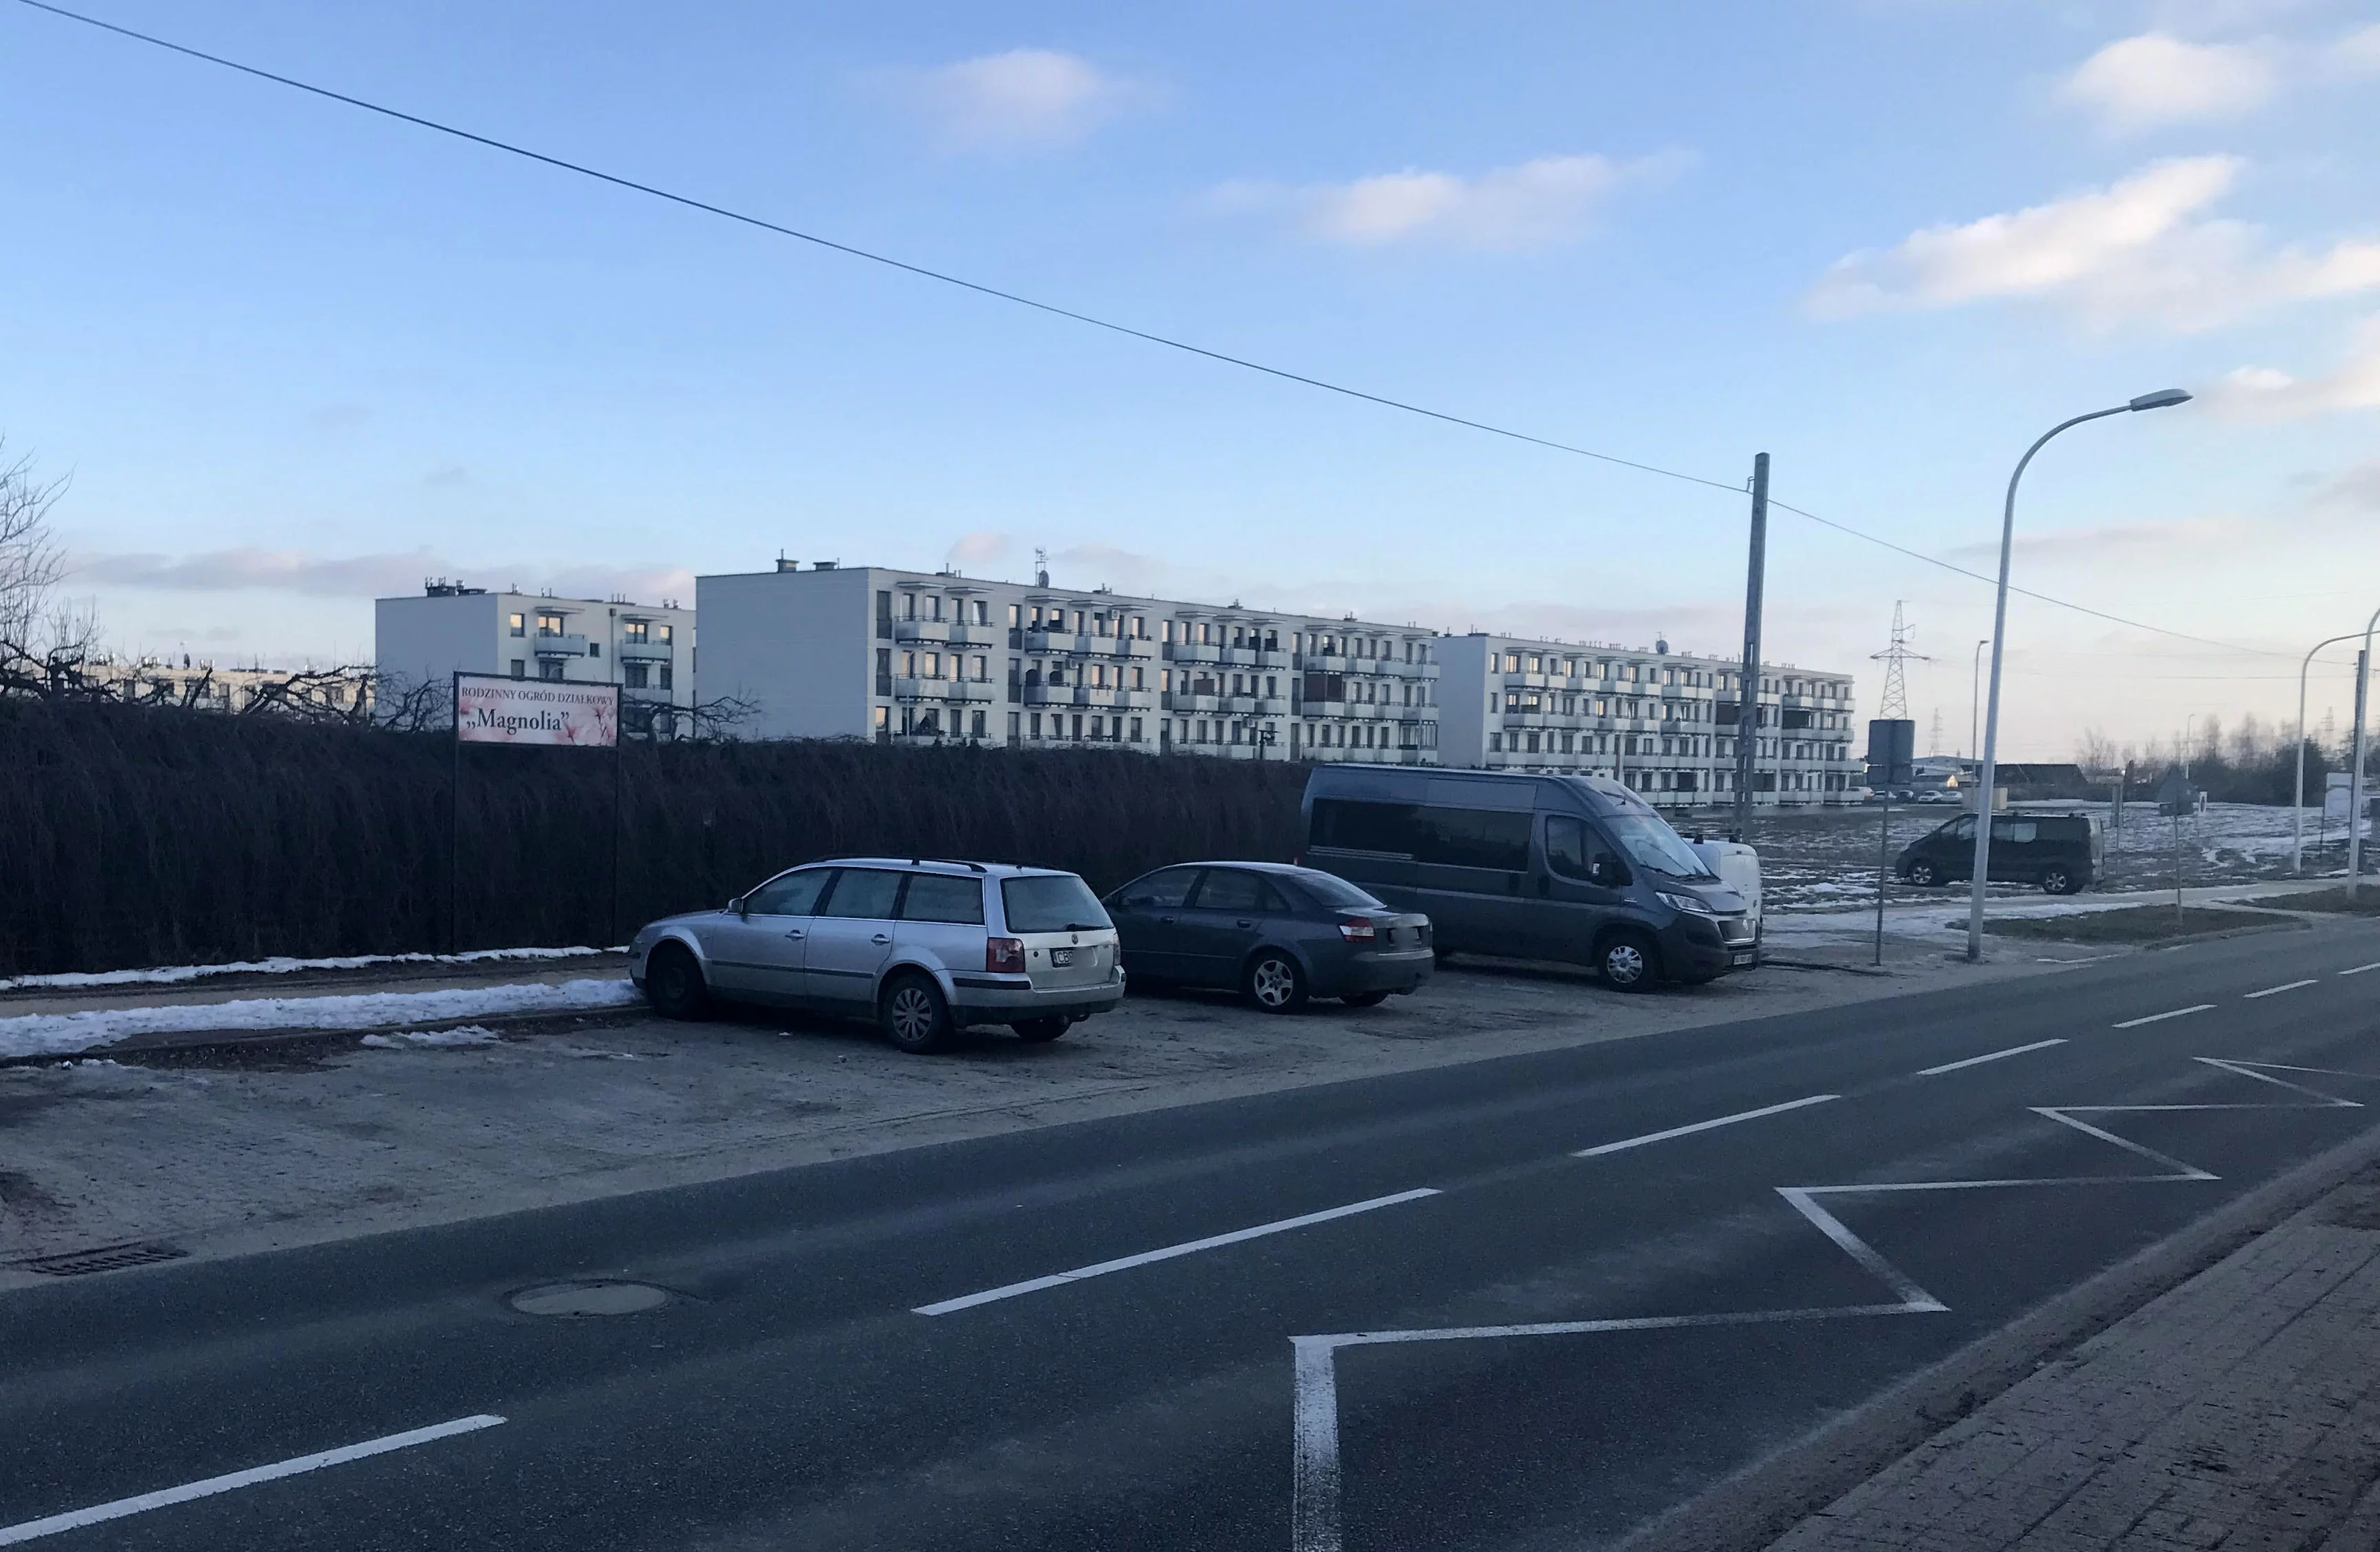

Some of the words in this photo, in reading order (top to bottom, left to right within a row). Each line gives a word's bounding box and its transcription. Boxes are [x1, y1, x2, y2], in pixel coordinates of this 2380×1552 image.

[461, 686, 516, 700] RODZINNY
[518, 690, 556, 702] OGRÓD
[558, 693, 614, 705] DZIAŁKOWY
[466, 708, 569, 735] „Magnolia”
